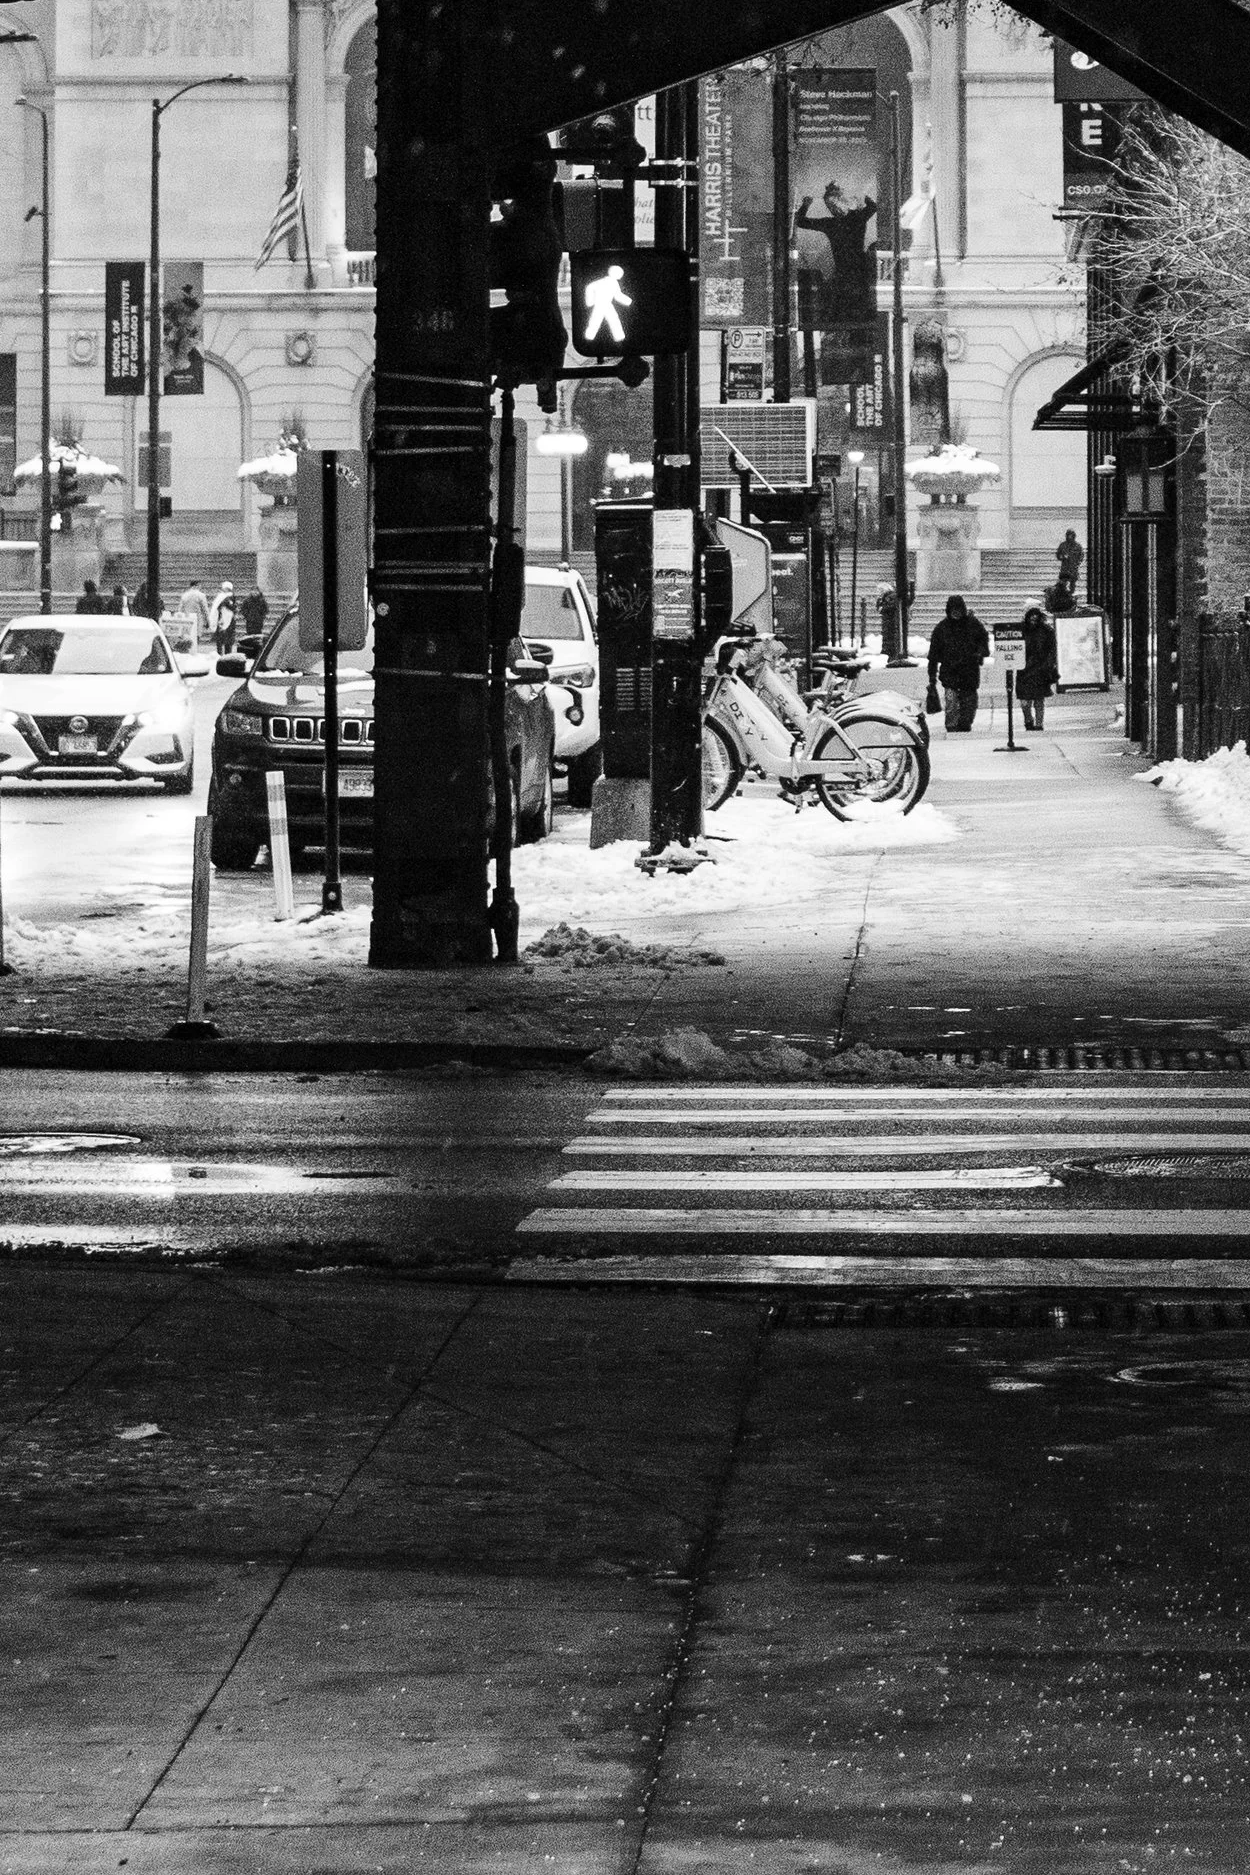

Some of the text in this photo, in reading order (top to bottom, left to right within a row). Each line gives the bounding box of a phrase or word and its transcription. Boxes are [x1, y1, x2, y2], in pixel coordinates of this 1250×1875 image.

[705, 162, 721, 235] HARRIS
[112, 320, 121, 378] SCHOOL OF
[121, 280, 130, 377] THE ART INSTITUTE
[130, 314, 138, 378] OF CHICAGO
[856, 385, 865, 426] SCHOOL
[866, 383, 874, 427] THE ART
[874, 364, 883, 427] OF CHICAGO
[995, 630, 1023, 638] CAUTION
